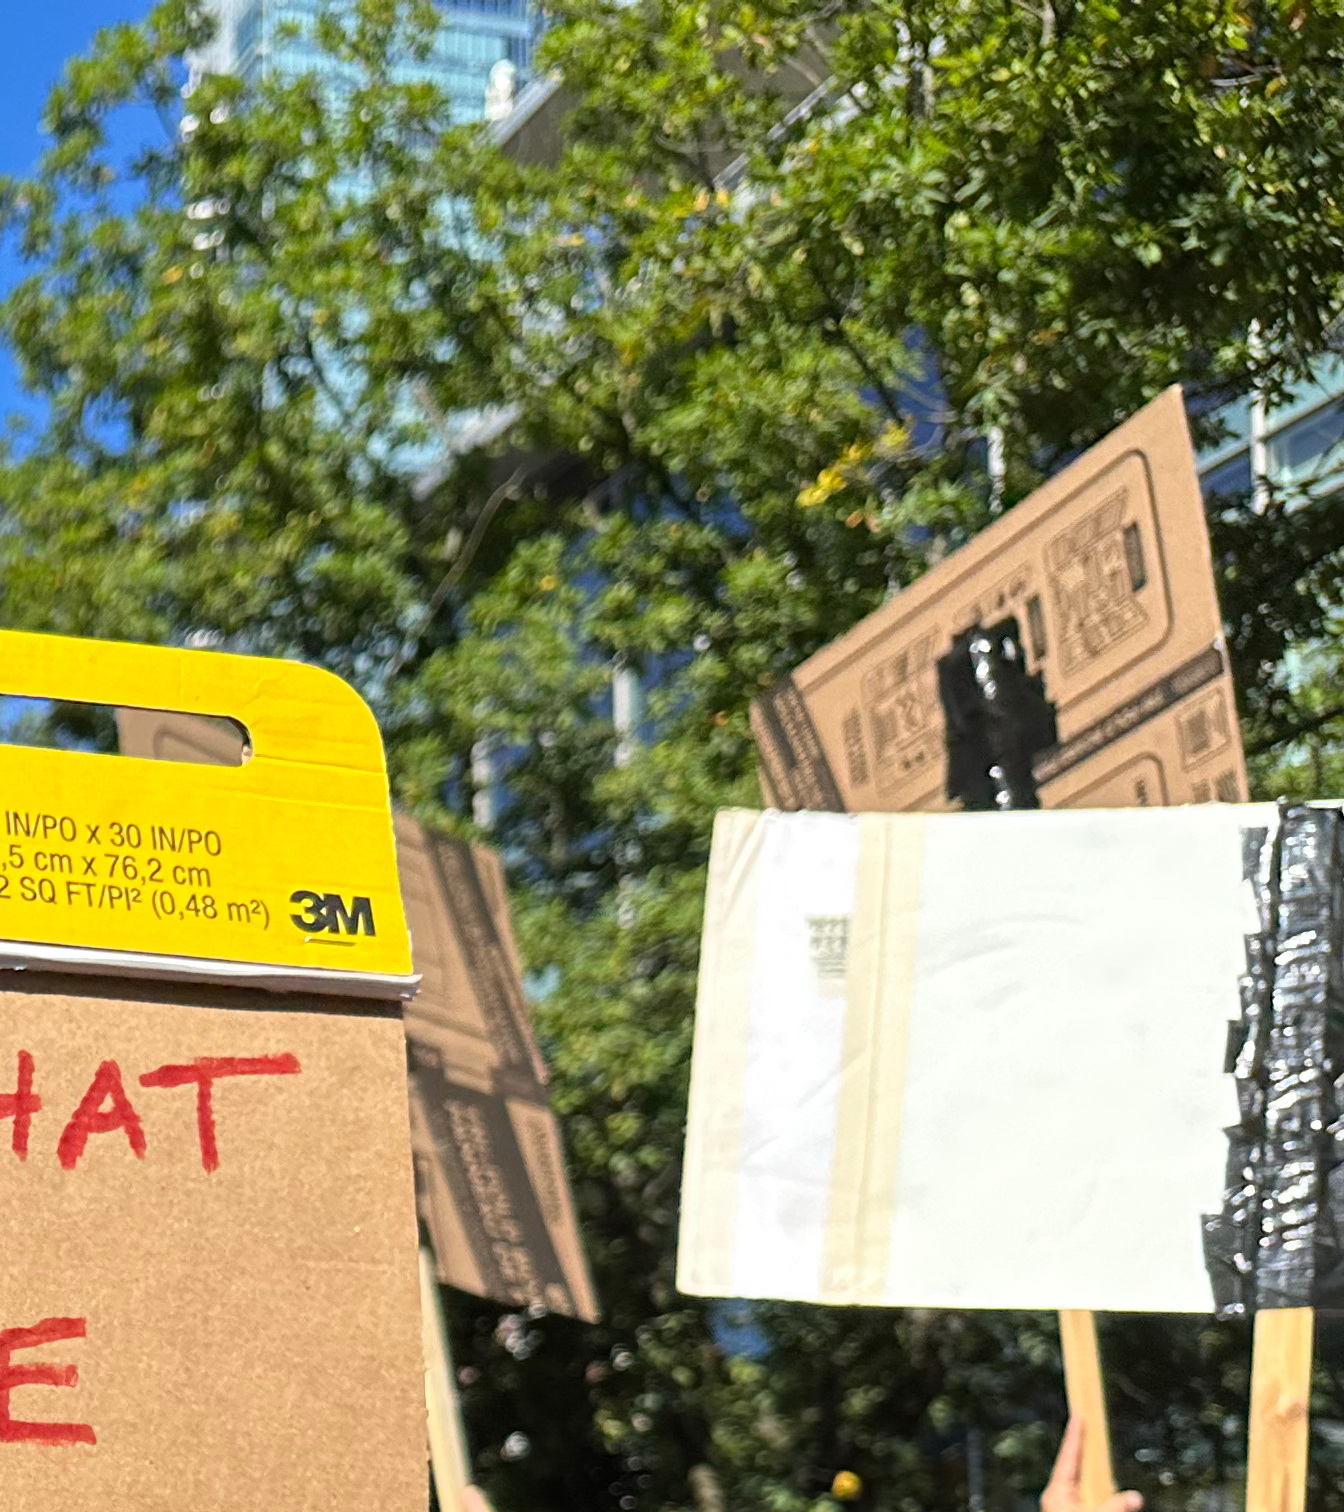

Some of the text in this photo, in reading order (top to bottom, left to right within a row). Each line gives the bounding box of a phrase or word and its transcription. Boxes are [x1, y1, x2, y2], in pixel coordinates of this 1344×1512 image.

[5, 810, 77, 843] IN/PO
[87, 824, 102, 845] x
[109, 822, 142, 850] 30
[151, 825, 222, 857] IN/PO
[34, 850, 73, 875] cm
[82, 855, 98, 877] x
[104, 853, 163, 884] 76,2
[172, 864, 212, 889] cm
[19, 876, 57, 906] SQ
[151, 888, 218, 921] (0,48
[288, 888, 377, 938] 3M
